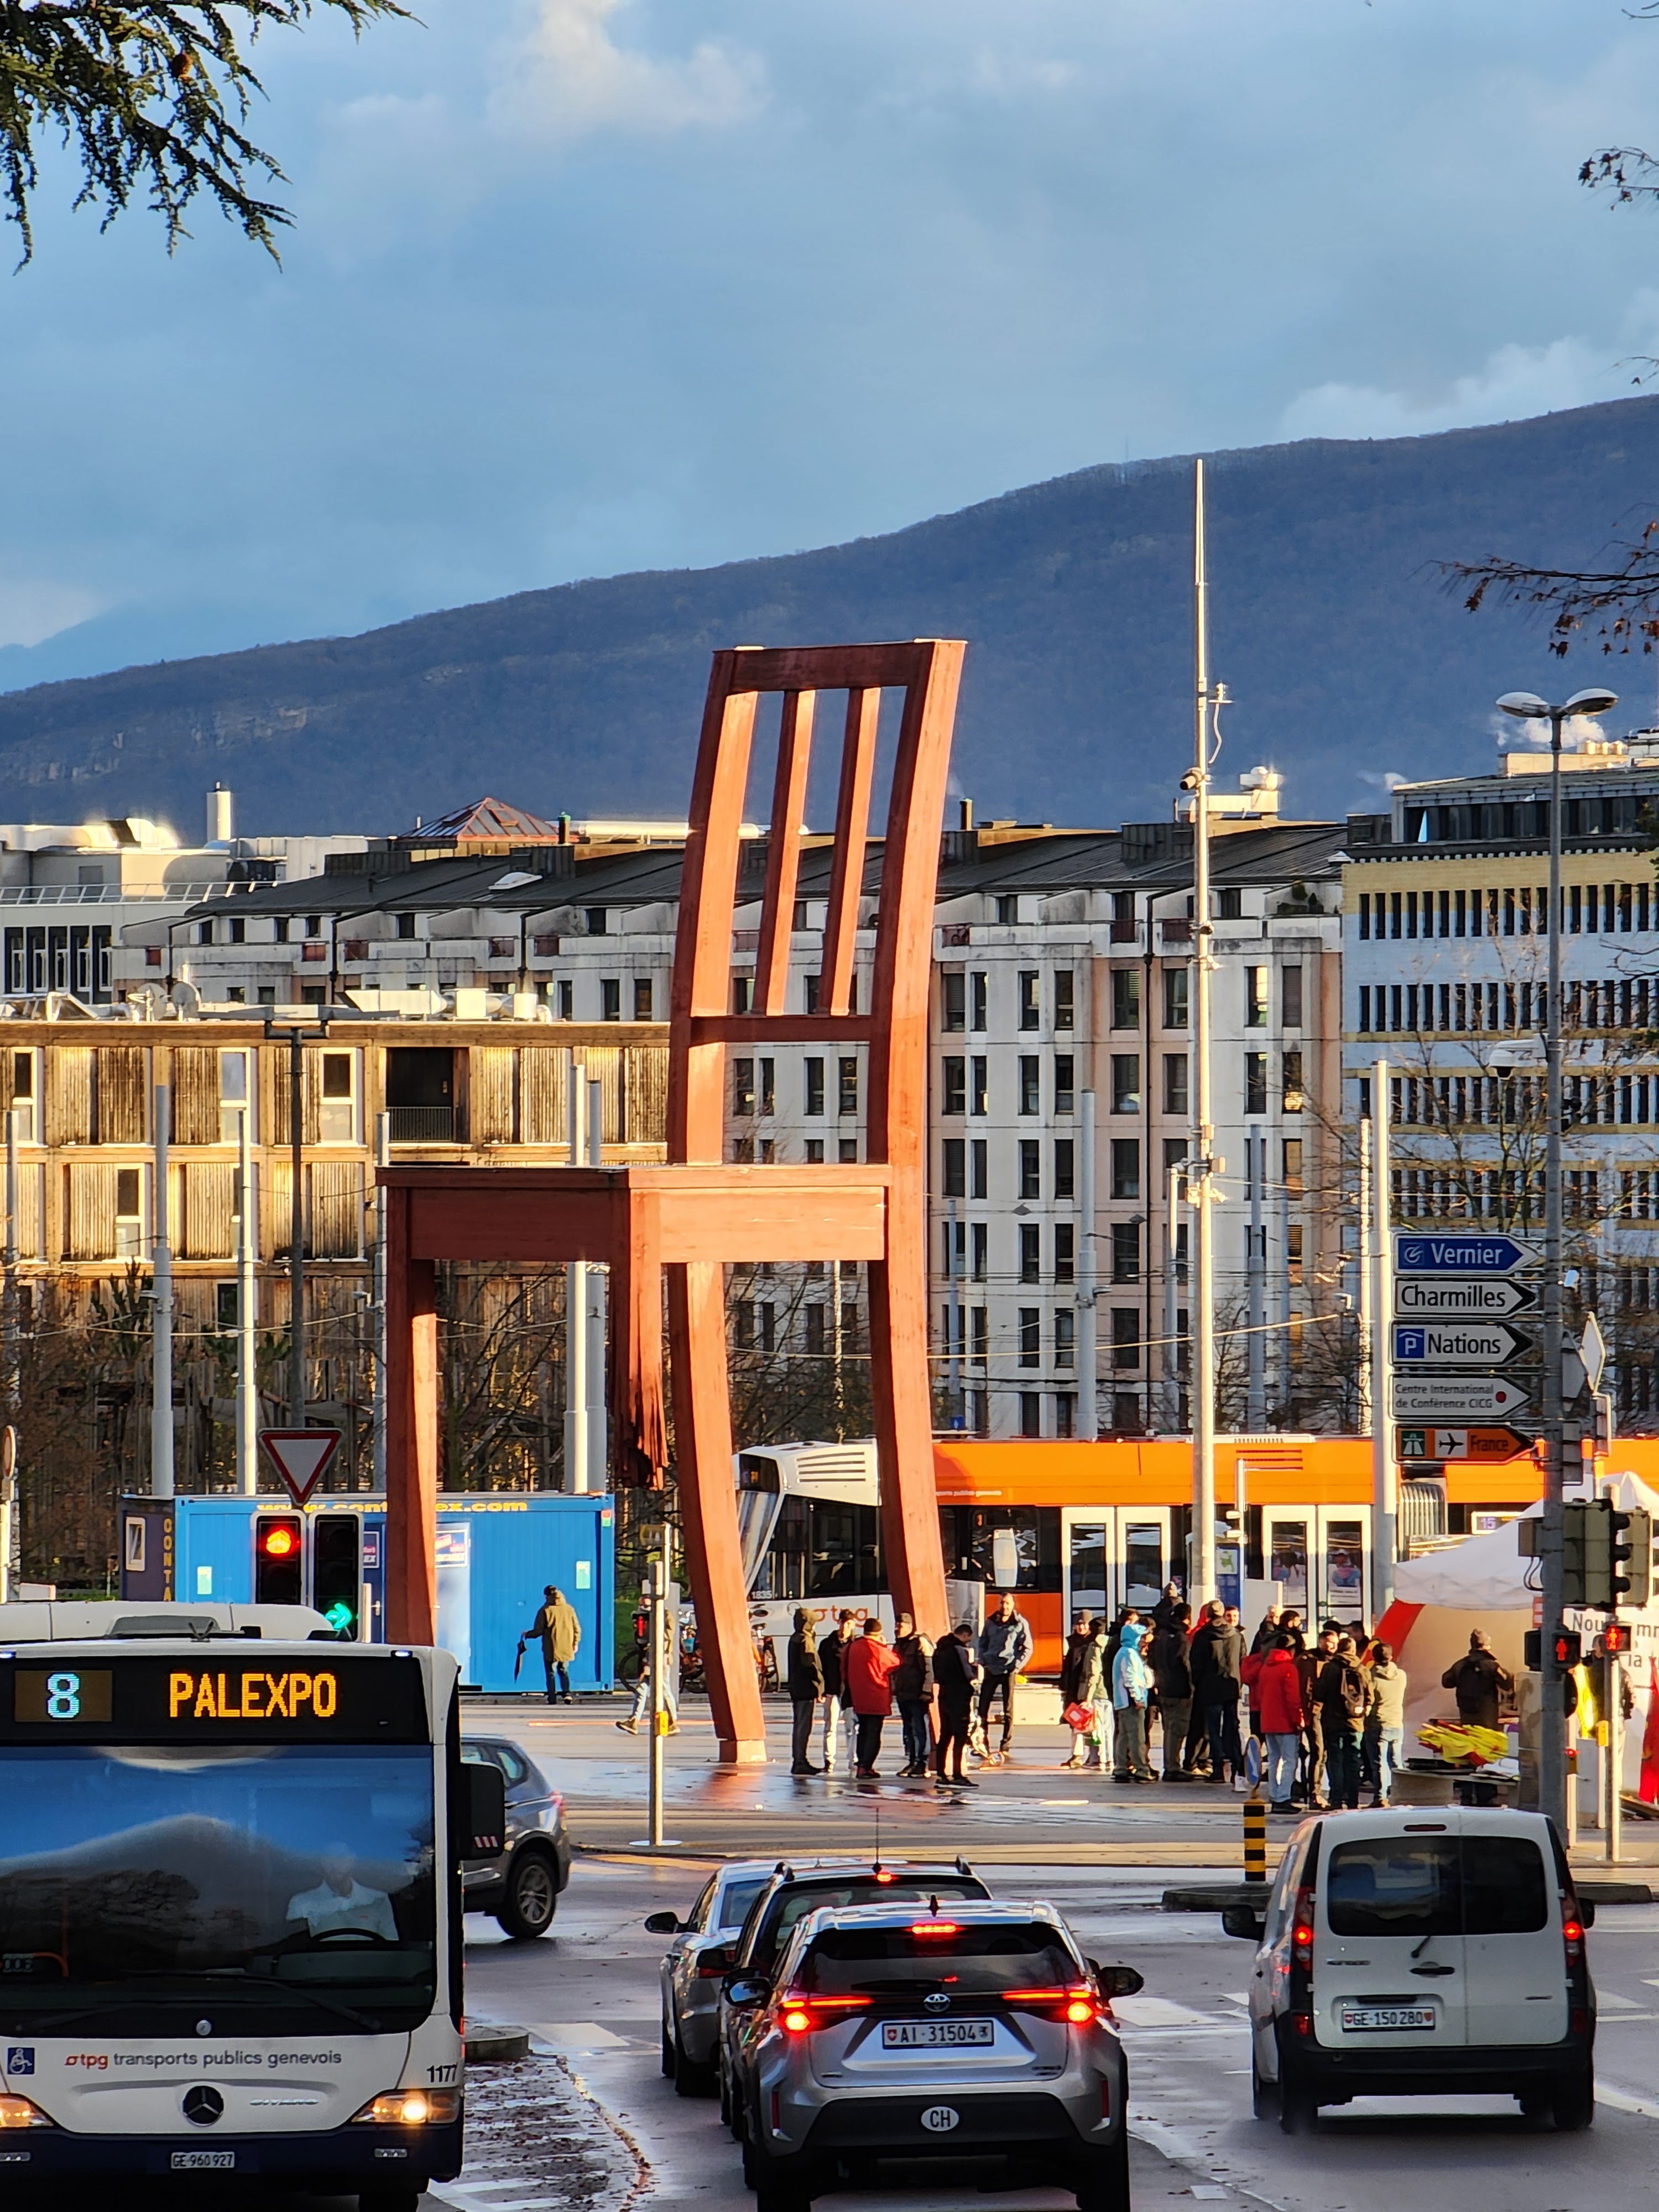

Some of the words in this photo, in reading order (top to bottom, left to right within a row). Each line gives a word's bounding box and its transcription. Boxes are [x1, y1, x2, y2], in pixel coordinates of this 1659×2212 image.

[1431, 1242, 1504, 1265] Vernier
[1401, 1284, 1506, 1307] Charmilles
[1427, 1332, 1501, 1354] Nations
[1395, 1384, 1428, 1394] Centre
[1430, 1384, 1494, 1394] International
[1396, 1397, 1408, 1408] de
[1469, 1398, 1493, 1408] CICG
[1470, 1434, 1510, 1452] France
[1480, 1516, 1496, 1530] 15
[750, 1590, 773, 1599] 1835
[47, 1673, 80, 1719] 8
[169, 1673, 337, 1718] PALEXPO
[113, 2053, 199, 2069] transports
[203, 2049, 263, 2069] publics
[268, 2050, 342, 2069] genevois
[426, 2064, 458, 2083] 1177
[930, 2110, 951, 2128] CH
